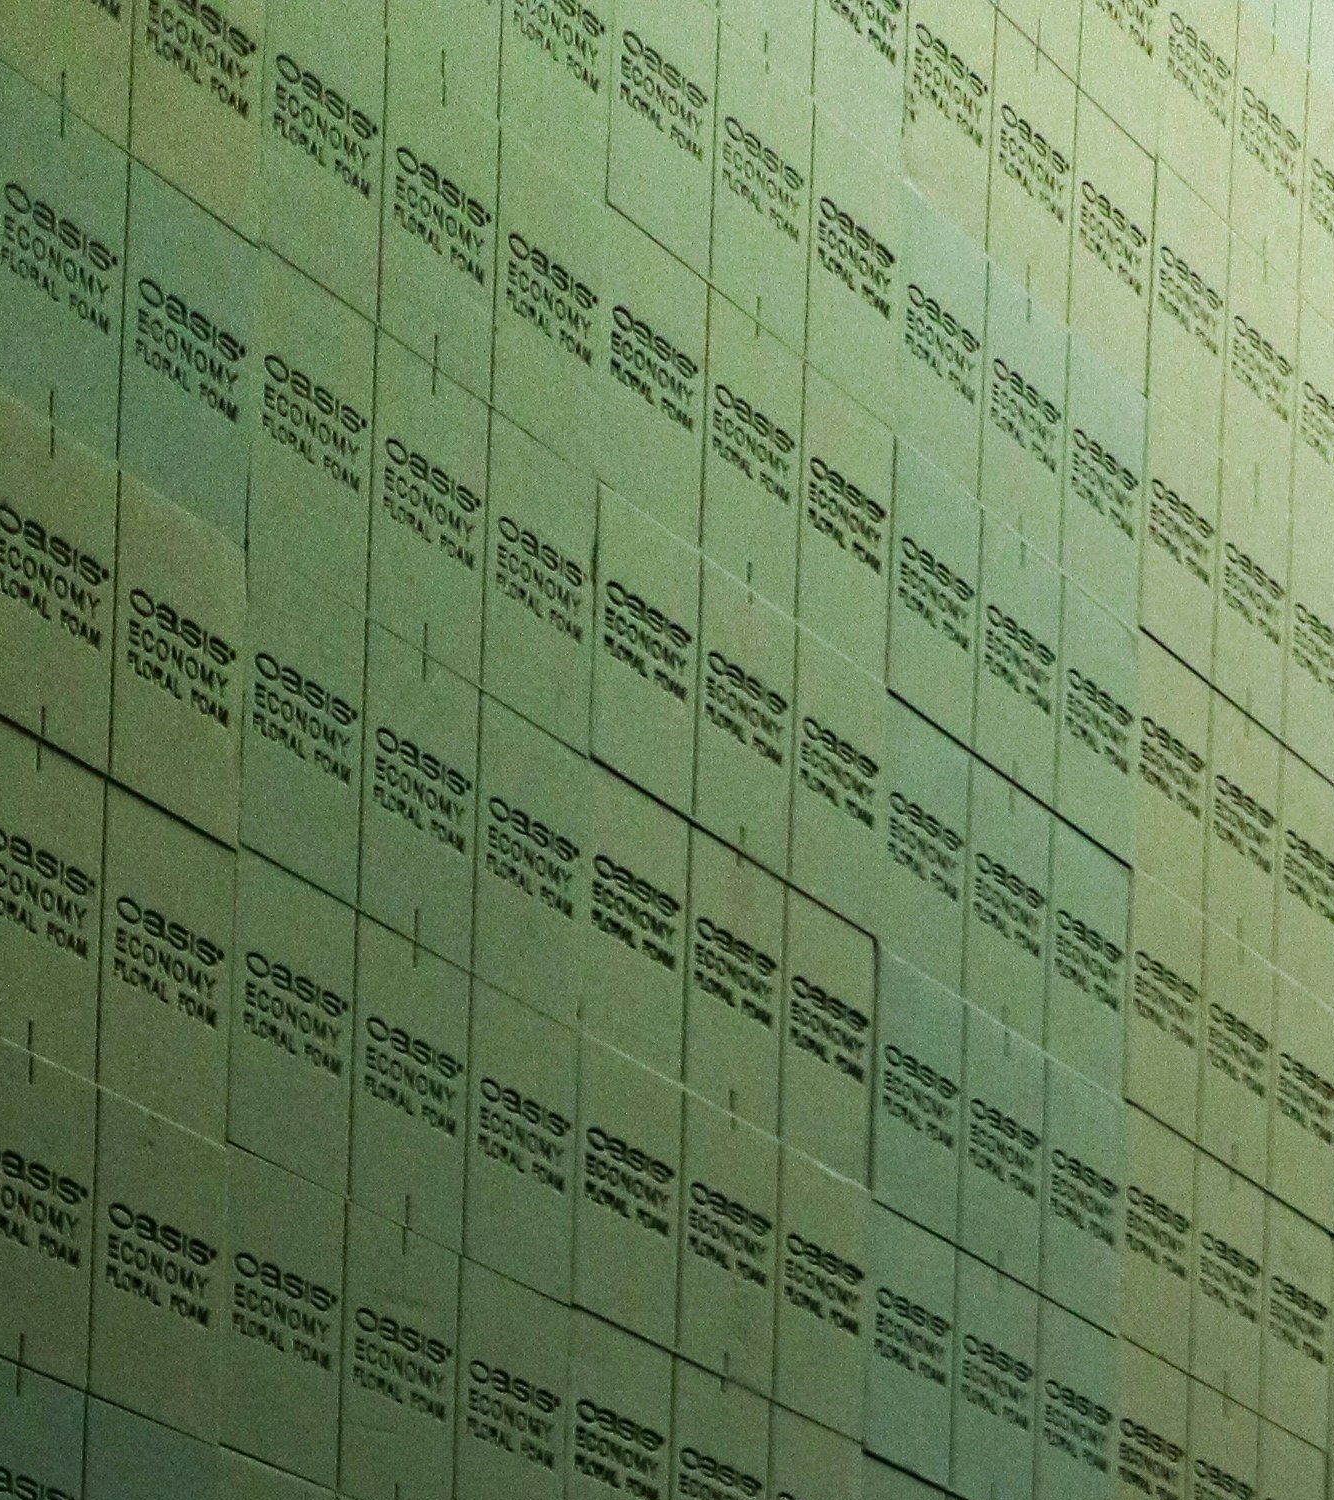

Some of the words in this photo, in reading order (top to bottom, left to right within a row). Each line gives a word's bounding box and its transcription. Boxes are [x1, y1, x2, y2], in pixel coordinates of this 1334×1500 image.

[126, 650, 182, 701] FLORAL
[191, 690, 230, 728] FOAM
[129, 619, 229, 697] ECONOMY
[232, 1313, 285, 1352] FLORAL
[293, 1340, 331, 1371] FOAM
[234, 1283, 330, 1341] ECONOMY
